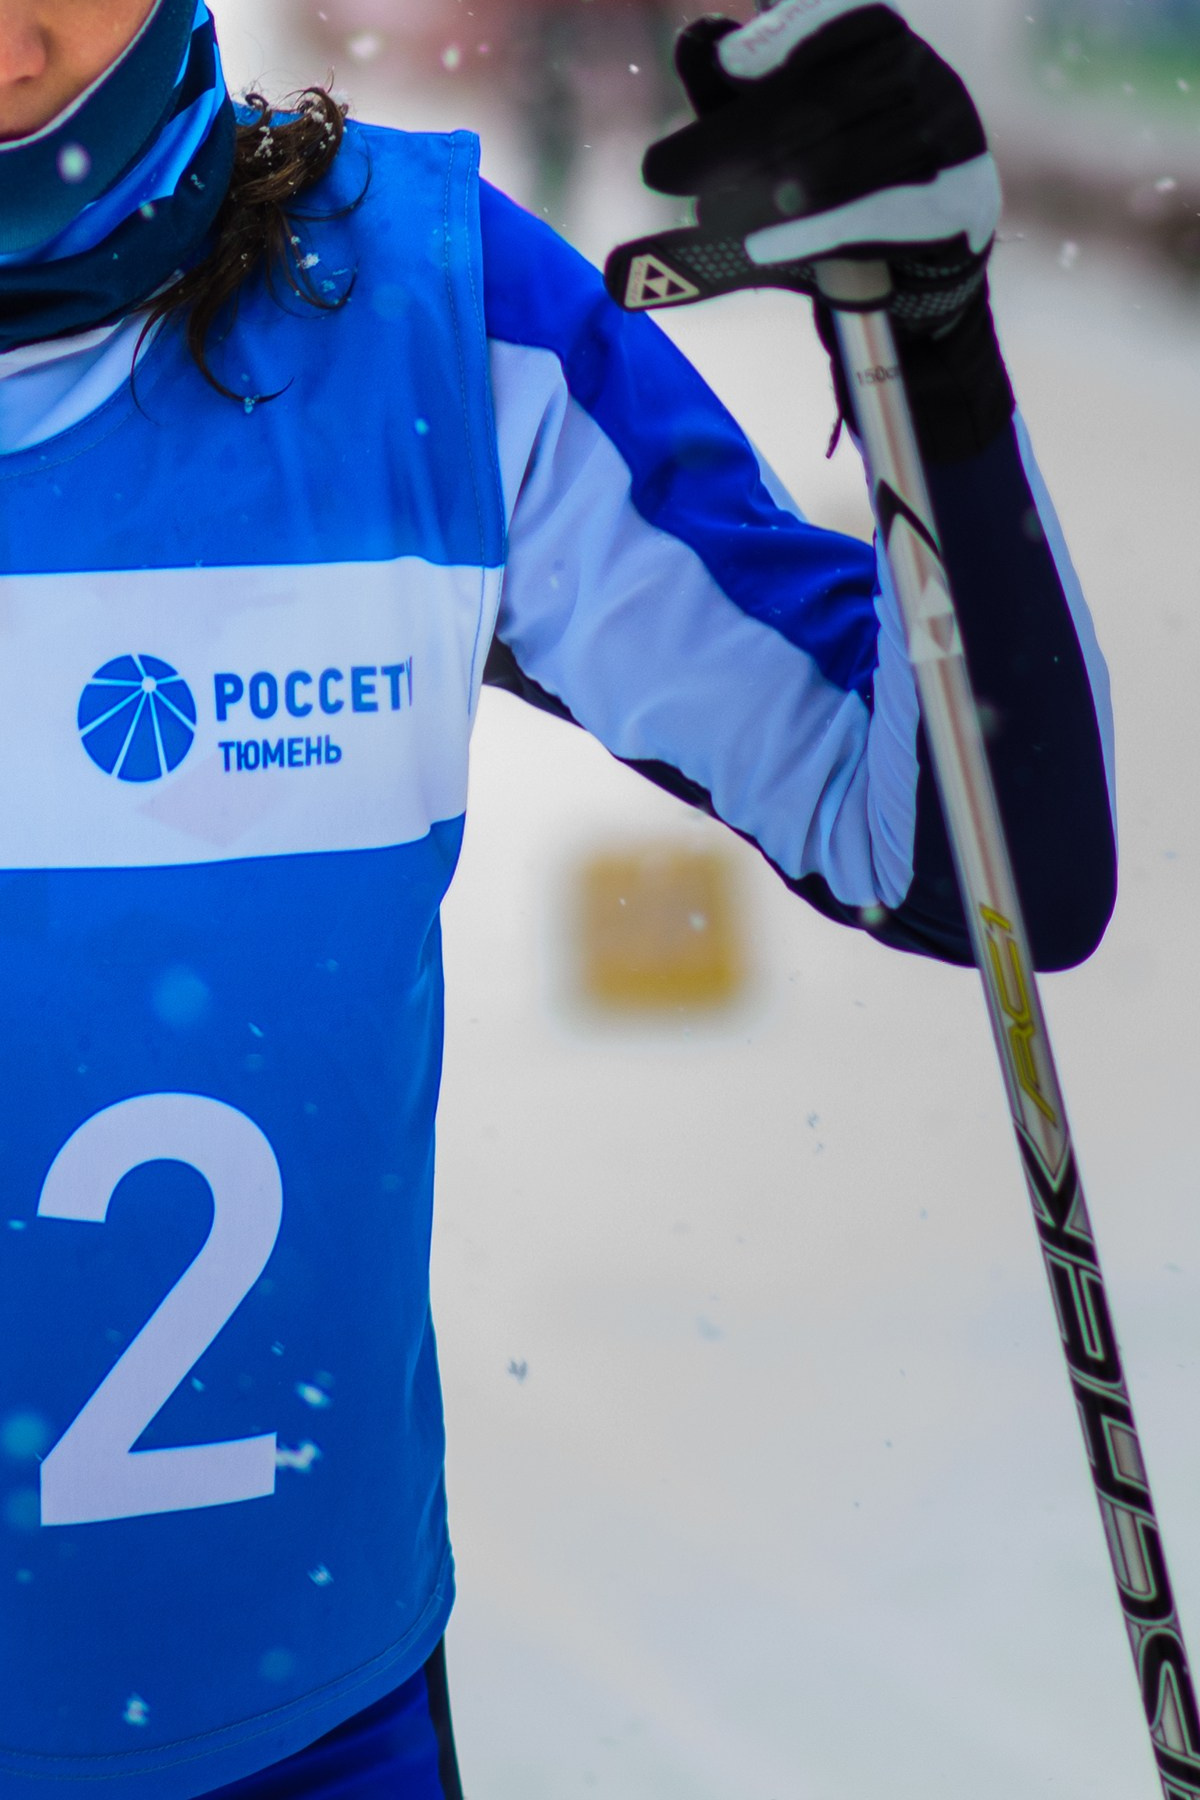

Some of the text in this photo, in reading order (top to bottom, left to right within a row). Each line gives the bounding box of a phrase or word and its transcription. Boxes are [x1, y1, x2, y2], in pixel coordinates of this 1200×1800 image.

[855, 364, 901, 388] 150c
[212, 655, 413, 723] РОССЕТ
[218, 734, 344, 773] ТЮМЕНЬ
